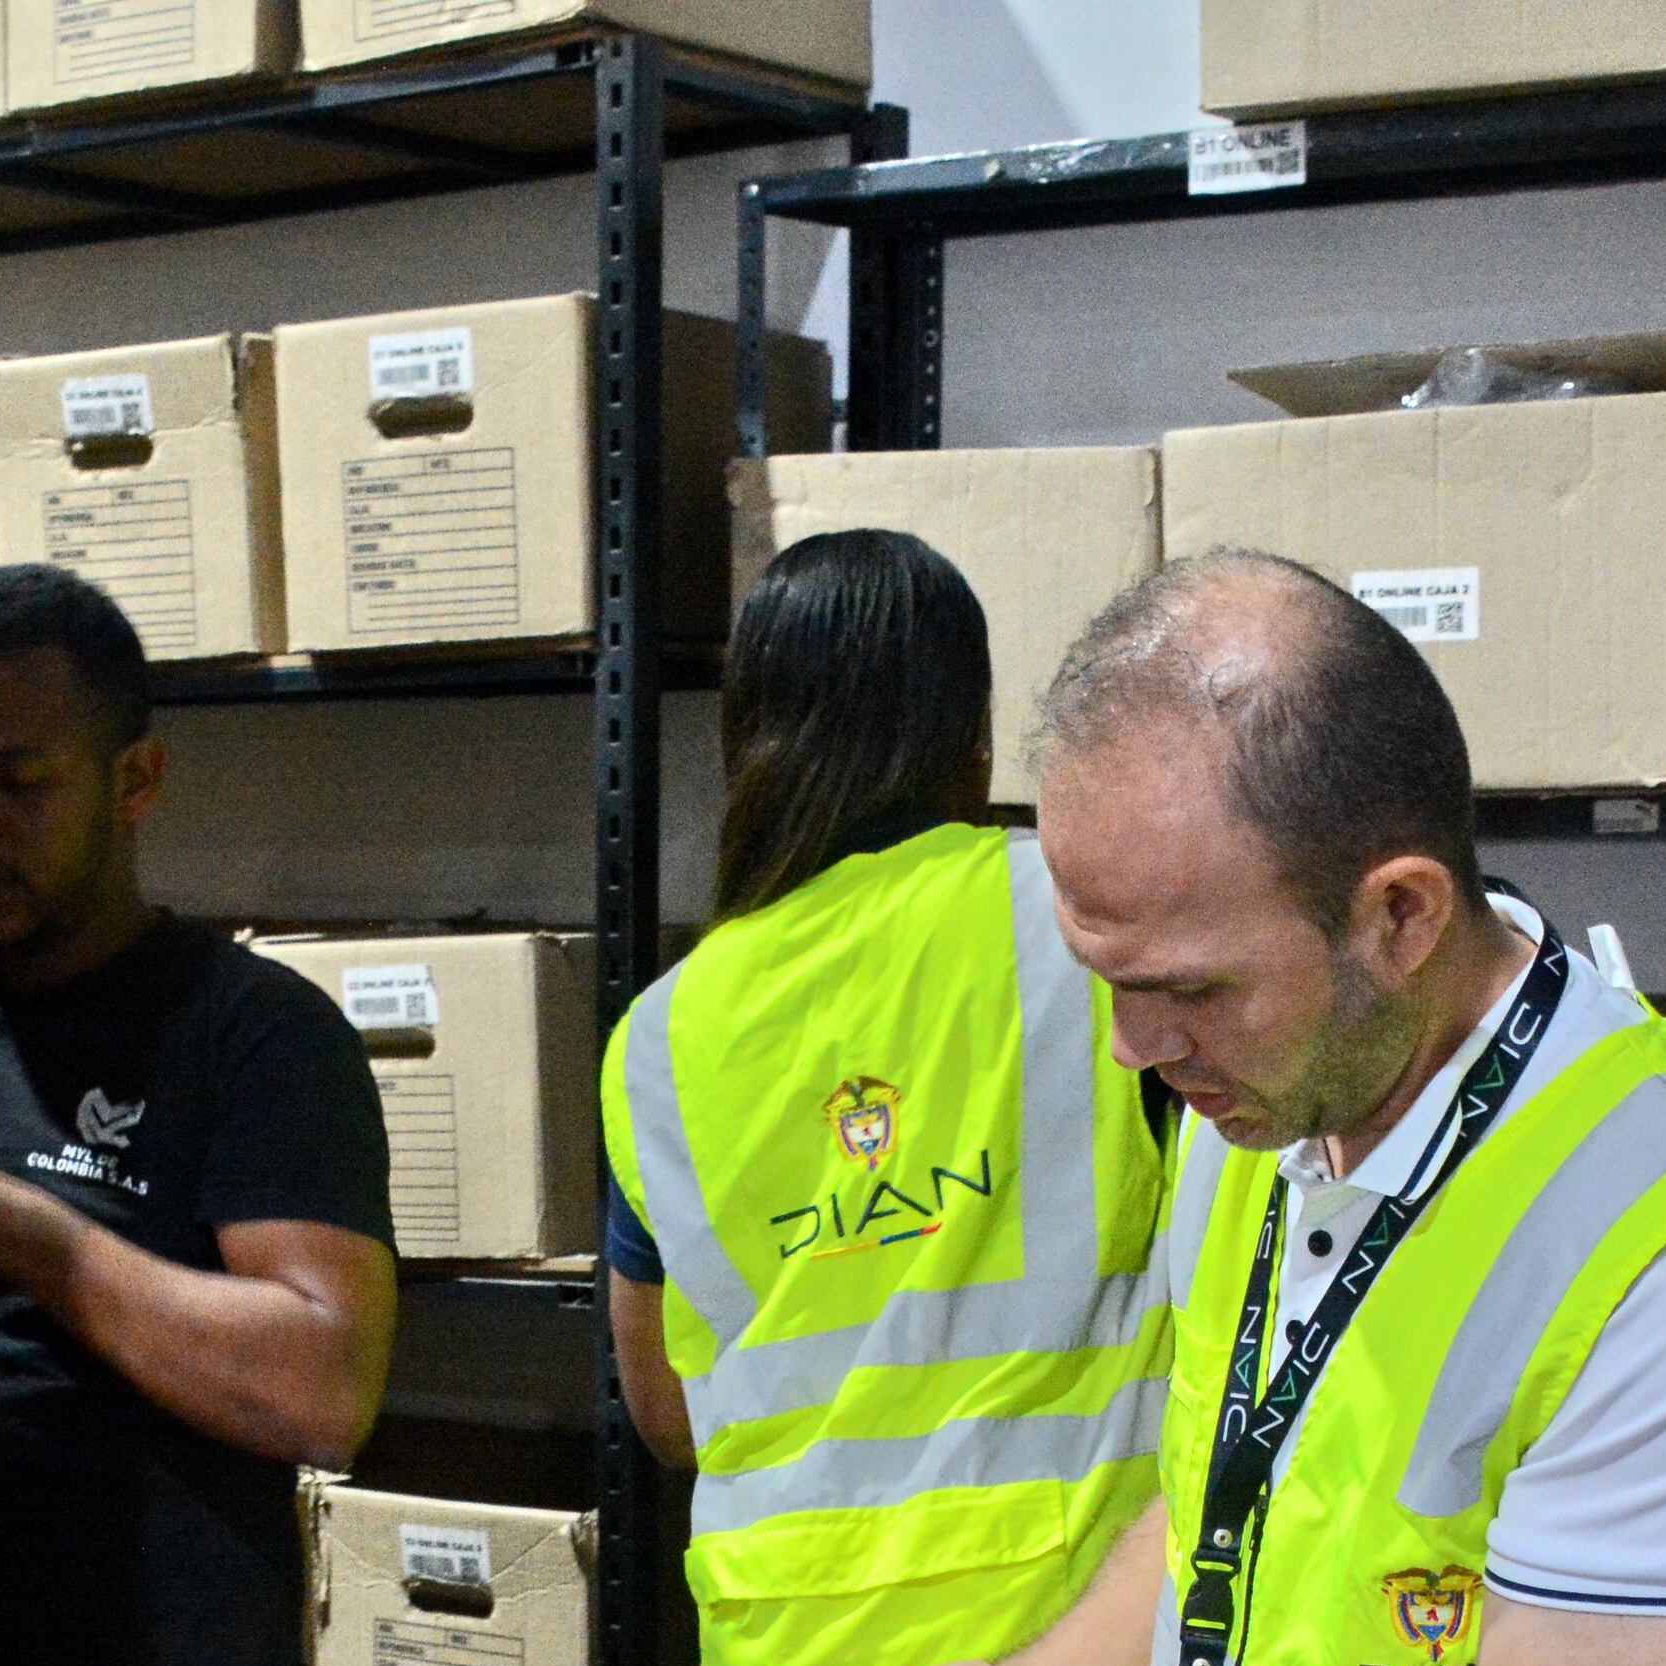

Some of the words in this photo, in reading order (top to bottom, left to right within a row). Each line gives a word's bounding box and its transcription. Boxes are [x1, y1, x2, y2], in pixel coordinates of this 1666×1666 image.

[1220, 129, 1291, 151] ONLINE
[1377, 586, 1422, 598] ONLINE
[1428, 585, 1457, 596] CAJA
[62, 1144, 93, 1163] MYL
[27, 1151, 103, 1180] COLOMBIA
[770, 1149, 992, 1259] DIAN
